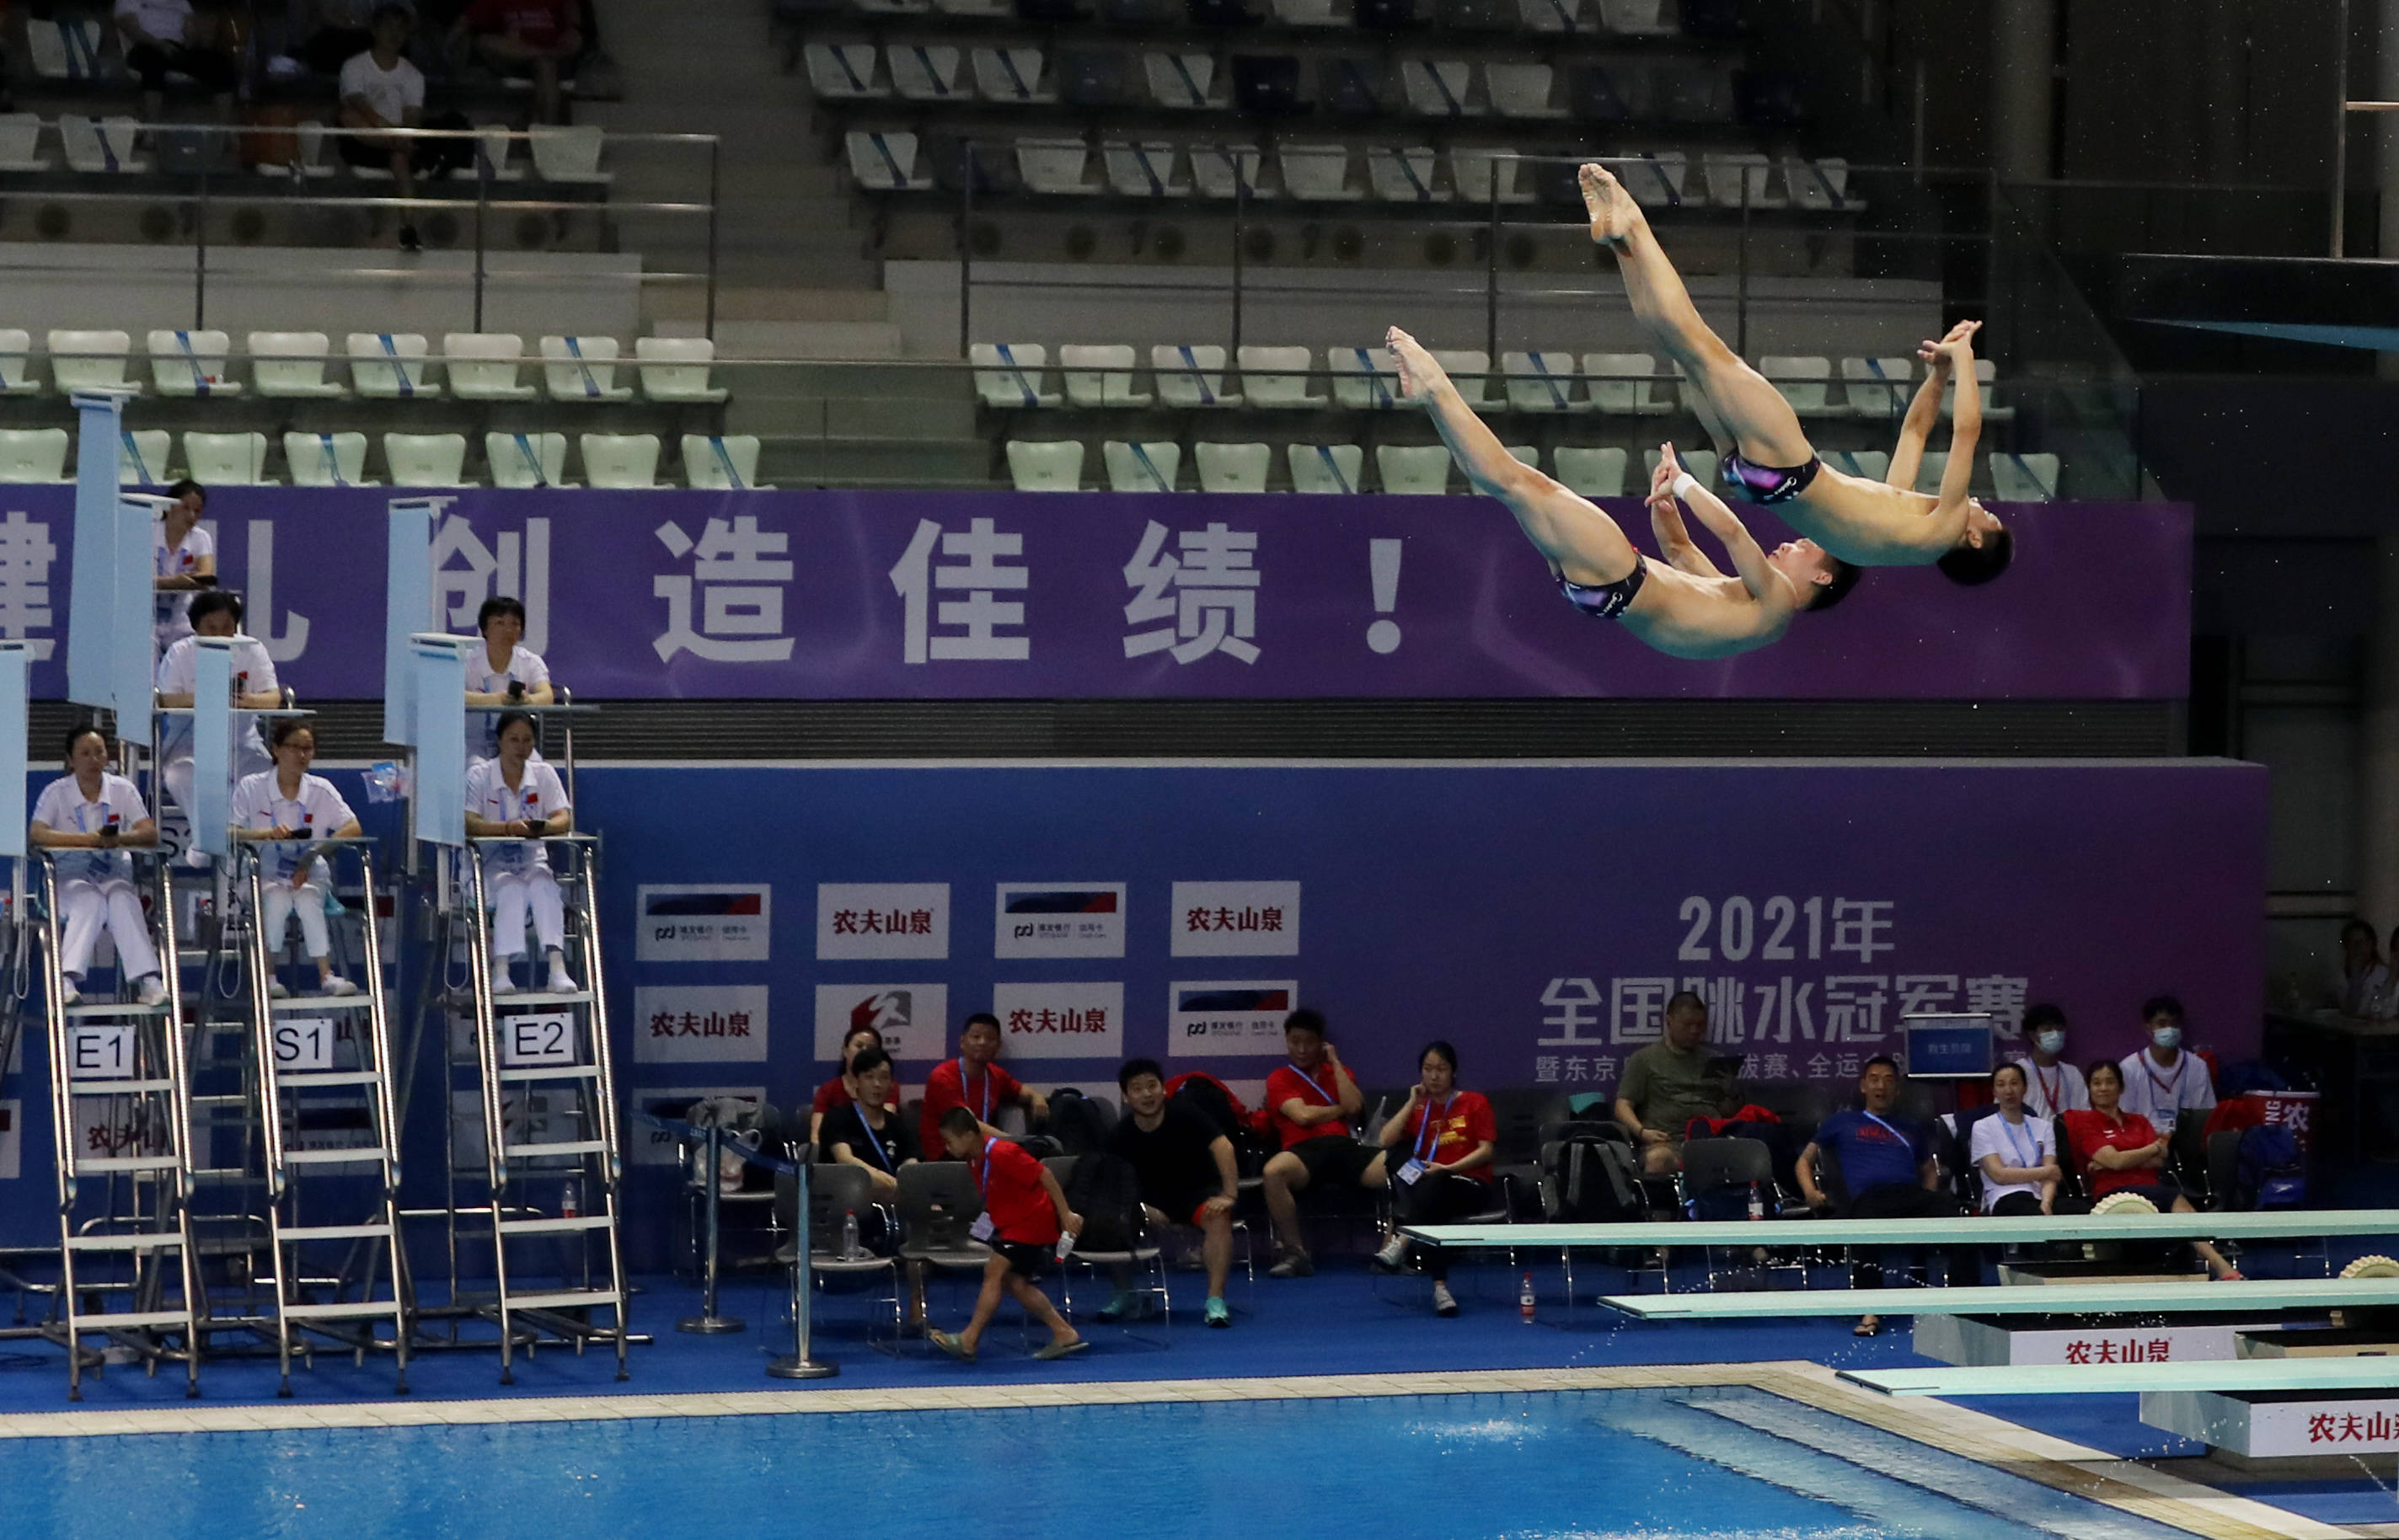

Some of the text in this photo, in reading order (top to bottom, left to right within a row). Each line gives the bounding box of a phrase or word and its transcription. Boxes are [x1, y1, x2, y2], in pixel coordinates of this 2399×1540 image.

[833, 908, 932, 935] 农夫山泉
[1186, 906, 1283, 933] 农夫山泉
[1678, 895, 1895, 963] 2021年
[651, 1011, 750, 1038] 农夫山泉
[1008, 1007, 1106, 1035] 农夫山泉
[76, 1035, 122, 1069] E1
[276, 1027, 321, 1061] S1
[515, 1022, 565, 1056] E2
[2066, 1338, 2170, 1365] 农夫山泉
[2308, 1410, 2399, 1443] 农夫山
